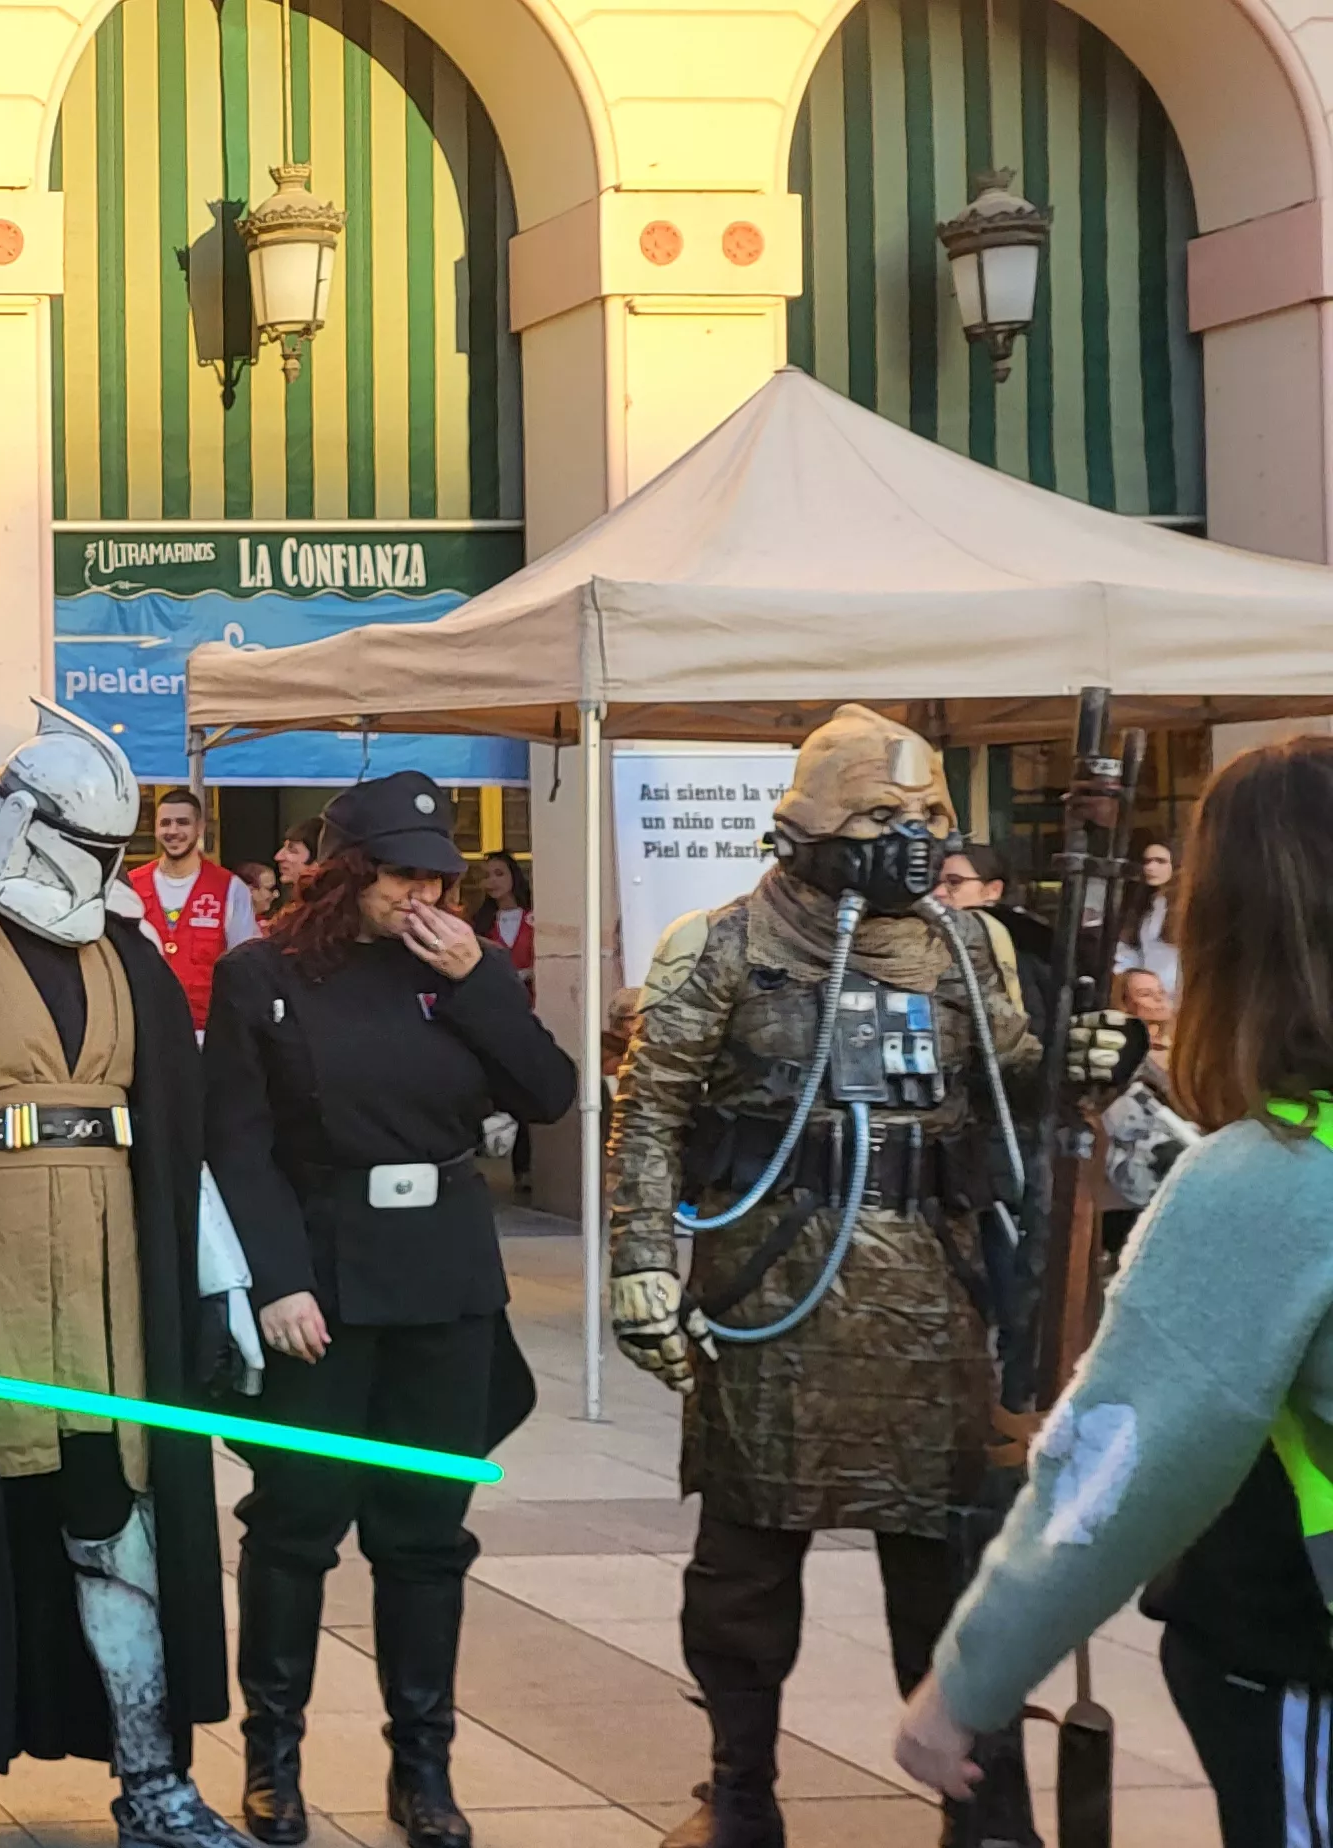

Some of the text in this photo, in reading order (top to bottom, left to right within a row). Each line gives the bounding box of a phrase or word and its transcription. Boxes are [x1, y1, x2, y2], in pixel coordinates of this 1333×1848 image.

[238, 537, 427, 588] LA CONFIANZA
[676, 783, 736, 801] siente
[742, 783, 761, 801] la
[641, 811, 756, 830] un niño con
[643, 841, 680, 859] Piel
[686, 841, 708, 859] de
